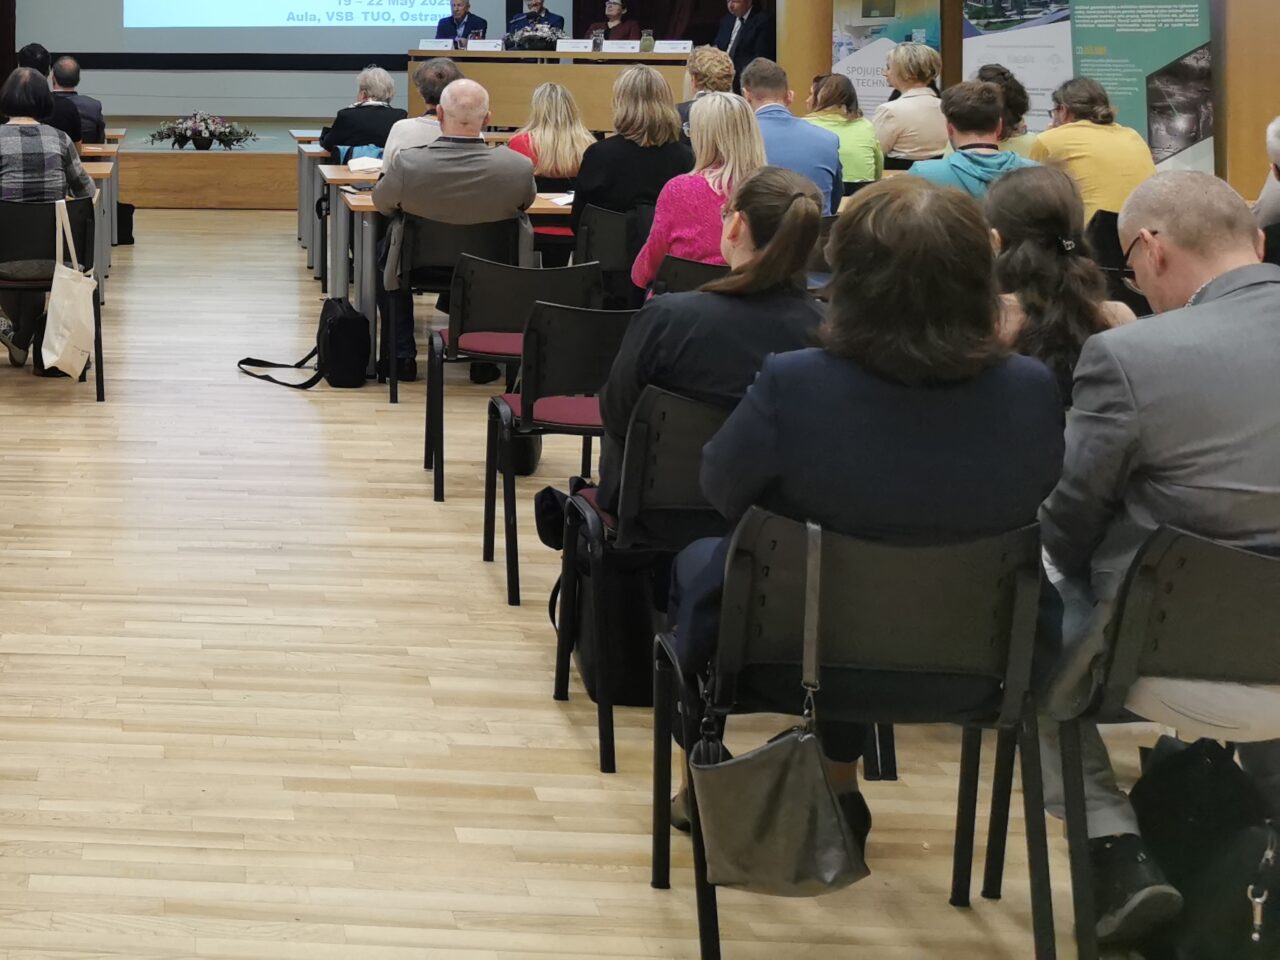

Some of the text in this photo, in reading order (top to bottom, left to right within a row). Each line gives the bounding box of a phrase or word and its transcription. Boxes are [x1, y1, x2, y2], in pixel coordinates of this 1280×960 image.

[287, 12, 321, 23] Aula,
[326, 12, 354, 21] VSB
[362, 12, 395, 23] TUO,
